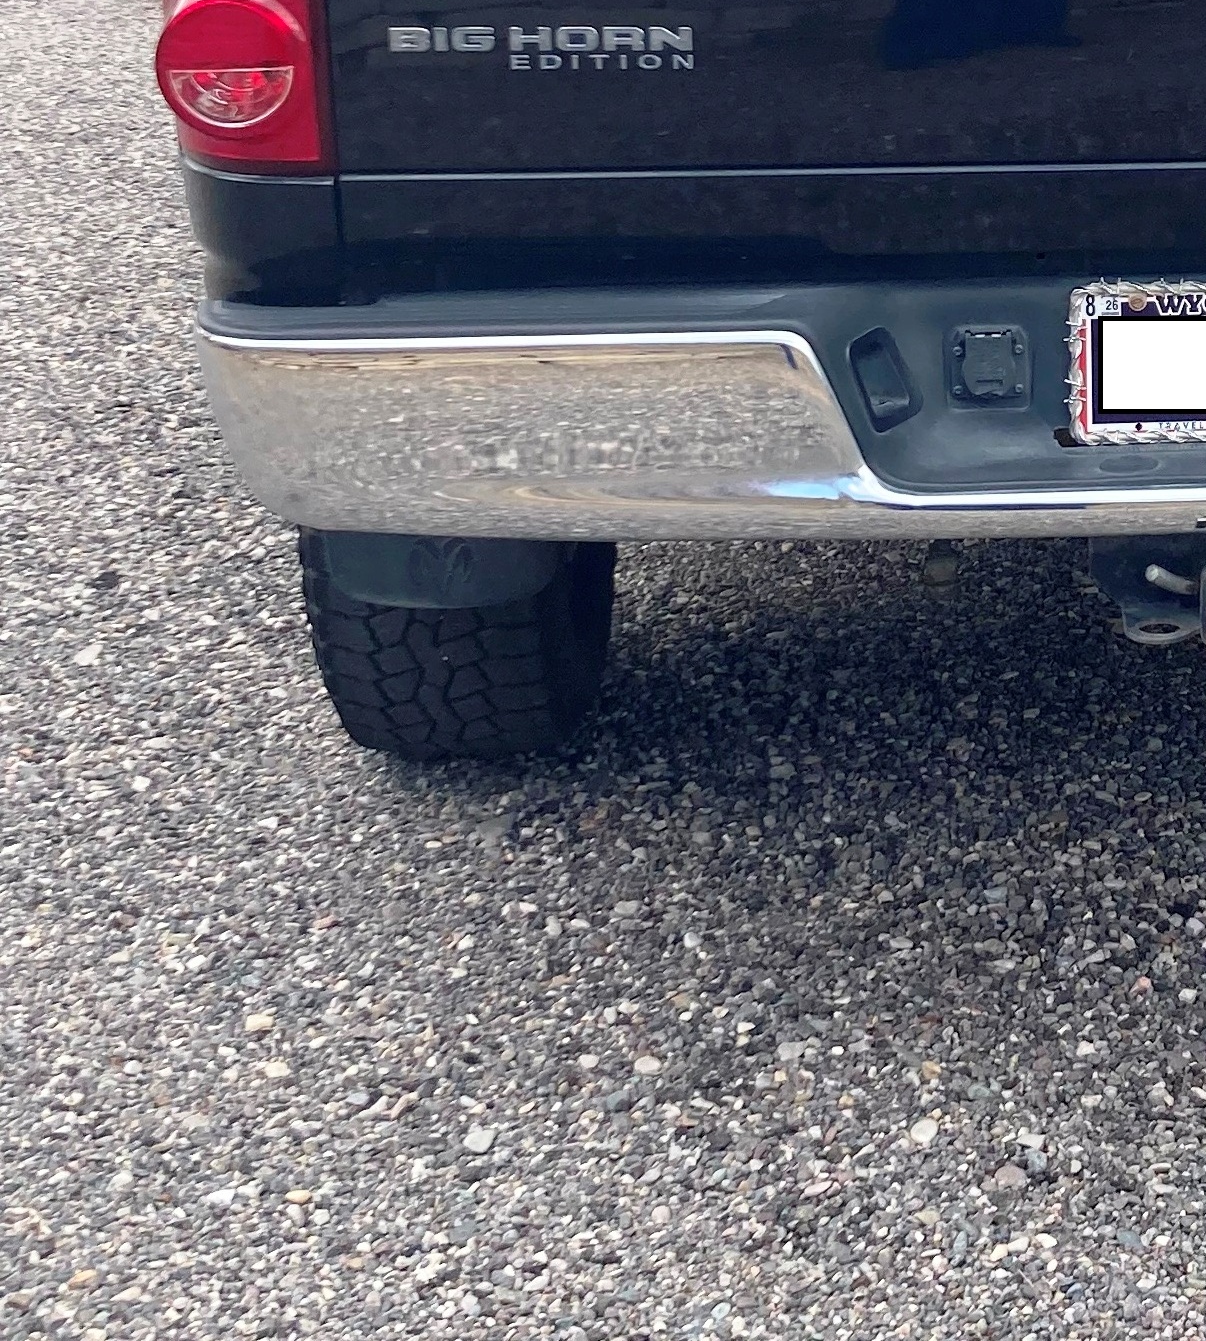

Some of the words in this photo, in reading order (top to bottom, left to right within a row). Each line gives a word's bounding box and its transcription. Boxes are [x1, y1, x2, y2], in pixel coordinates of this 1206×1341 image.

[387, 25, 496, 53] BIG
[508, 25, 694, 53] HORN
[509, 54, 695, 71] EDITION
[1085, 293, 1096, 317] 8
[1105, 299, 1119, 311] 26
